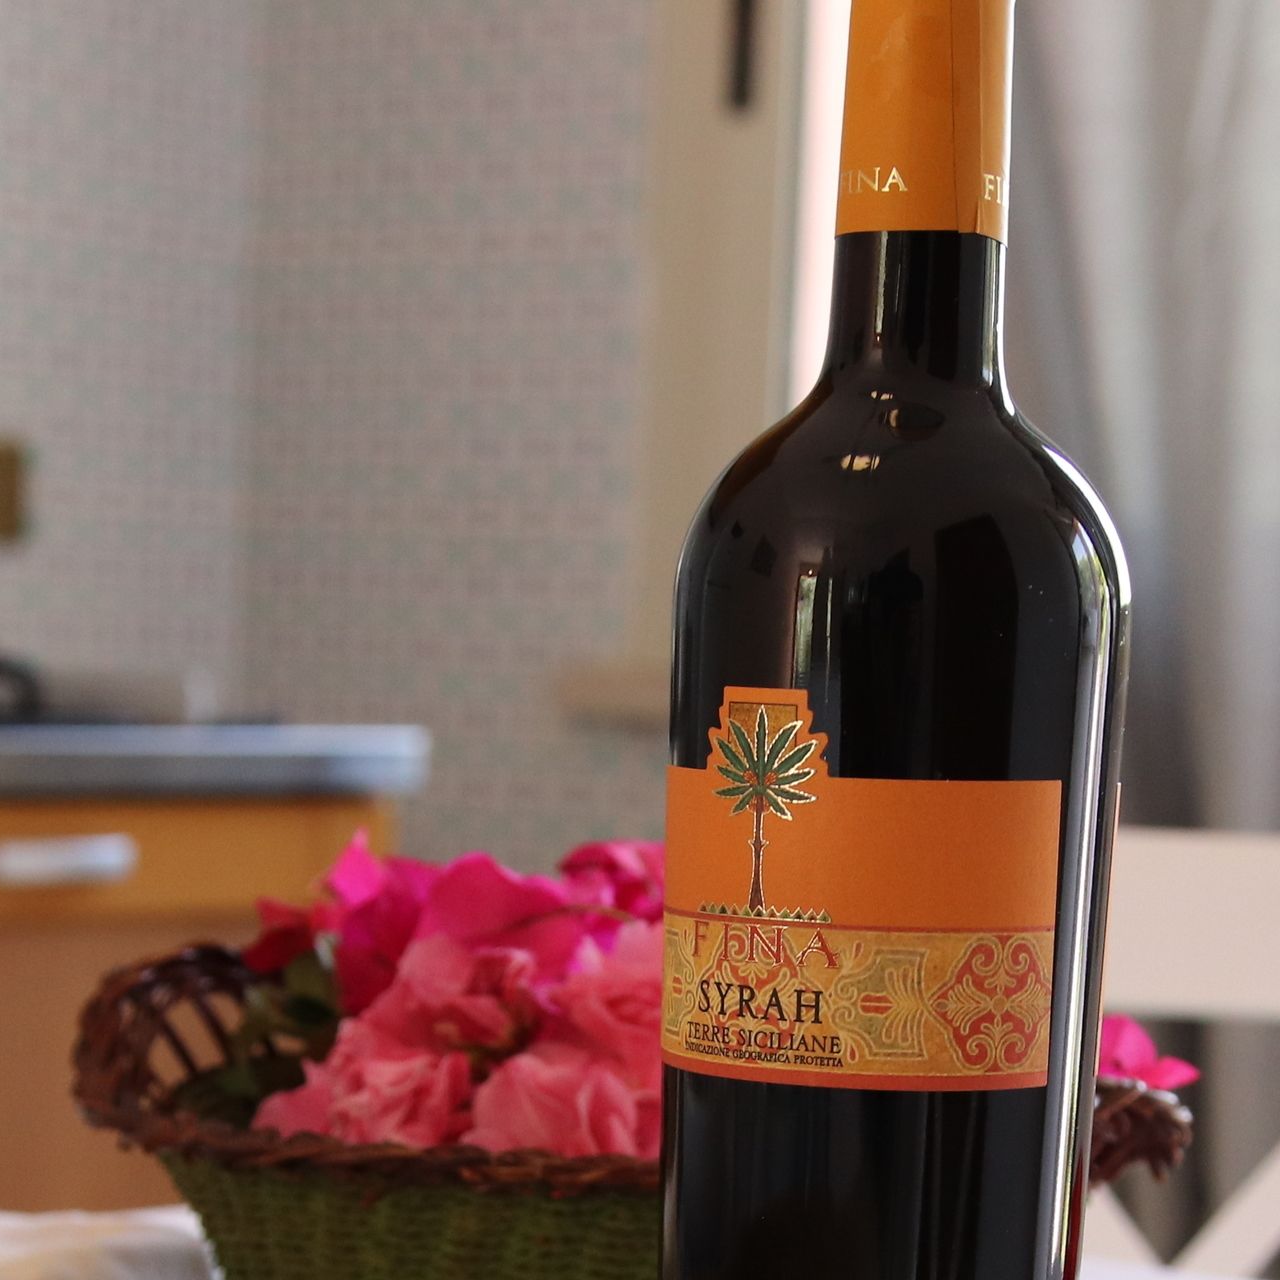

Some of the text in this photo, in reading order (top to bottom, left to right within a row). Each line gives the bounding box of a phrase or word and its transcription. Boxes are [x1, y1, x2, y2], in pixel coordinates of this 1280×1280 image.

[983, 173, 1005, 205] FI
[692, 919, 840, 969] FINA
[697, 979, 823, 1024] SYRAH
[685, 1040, 844, 1068] INDICAZIONE GEOGRAFICA PROTETTA
[687, 1021, 842, 1055] TERRE SICILIANE
